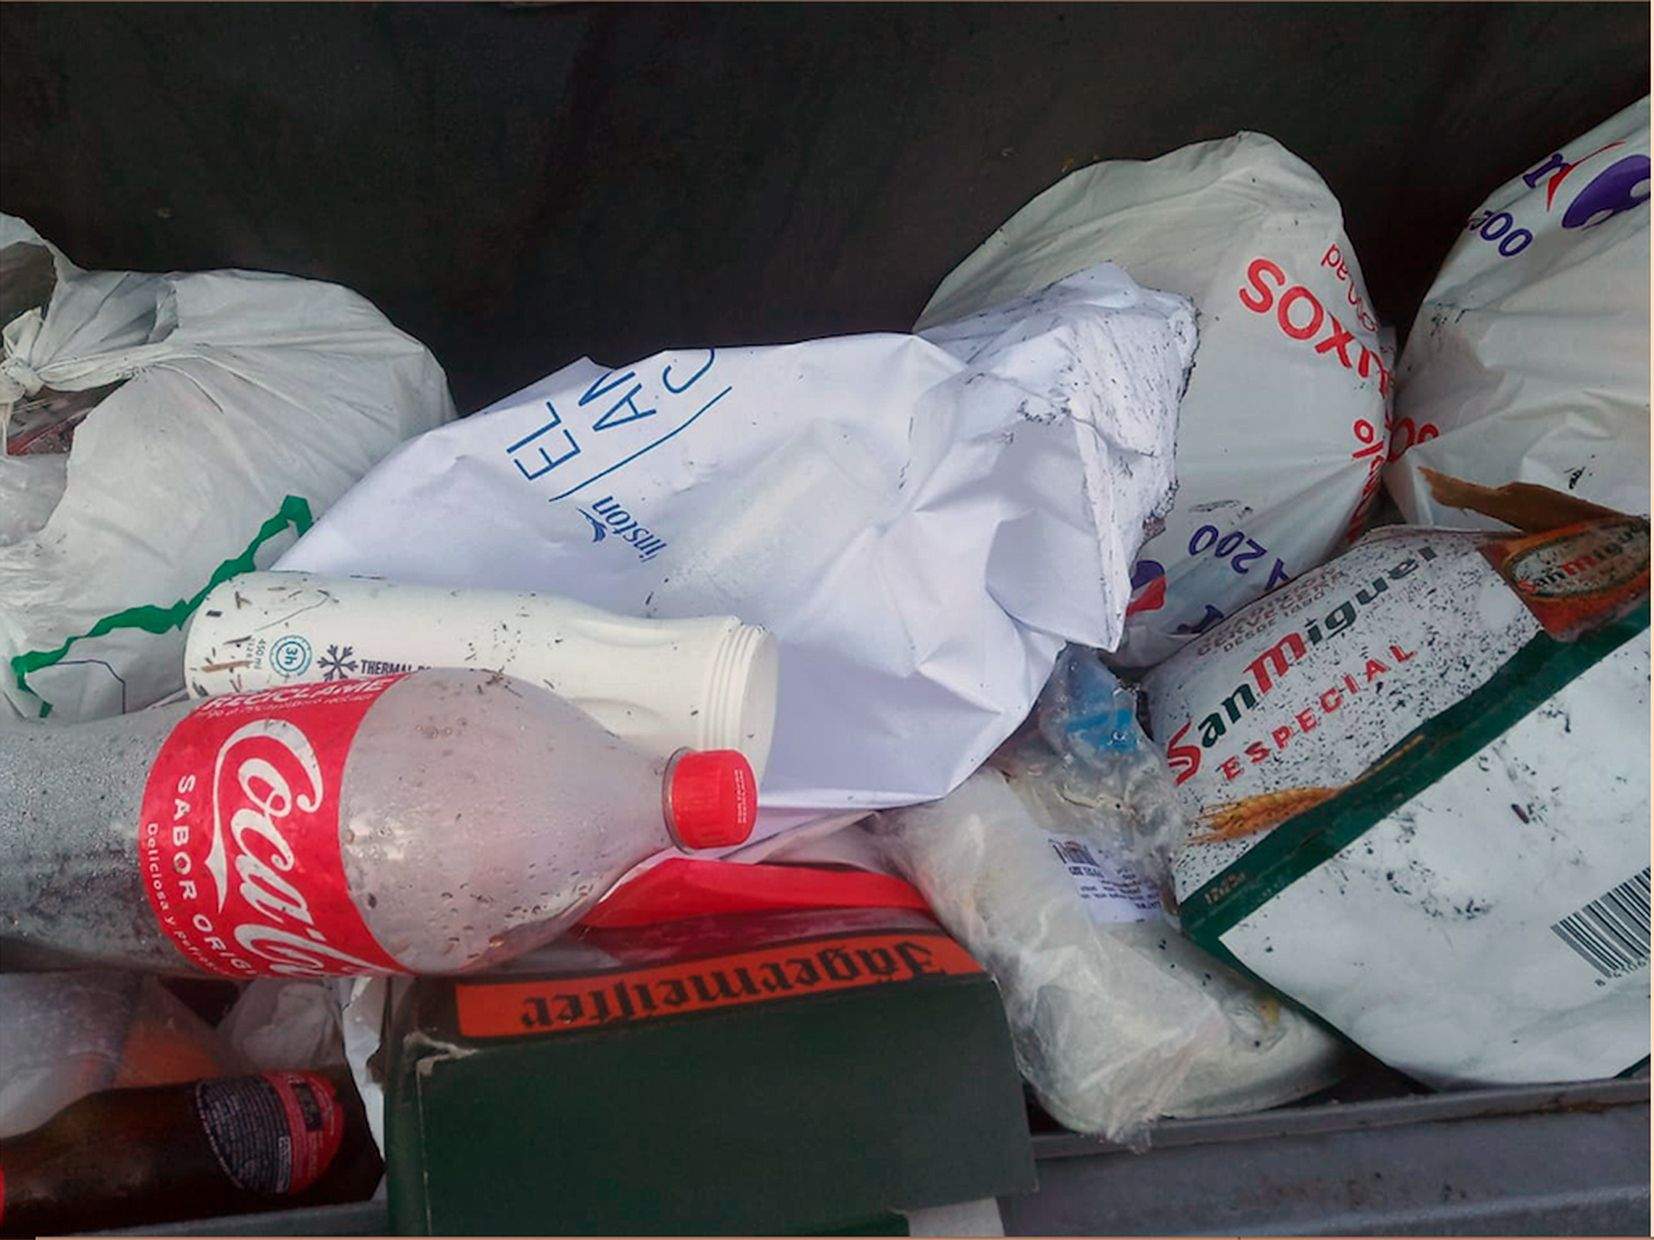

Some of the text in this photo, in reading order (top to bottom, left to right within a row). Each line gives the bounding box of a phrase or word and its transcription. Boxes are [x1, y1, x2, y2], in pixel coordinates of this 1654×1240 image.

[506, 401, 581, 480] EL
[1188, 524, 1268, 575] 200
[203, 677, 395, 711] RECICLAME
[1220, 643, 1419, 783] ESPECIAL
[146, 822, 171, 909] Deliciosa
[172, 774, 198, 900] SABOR
